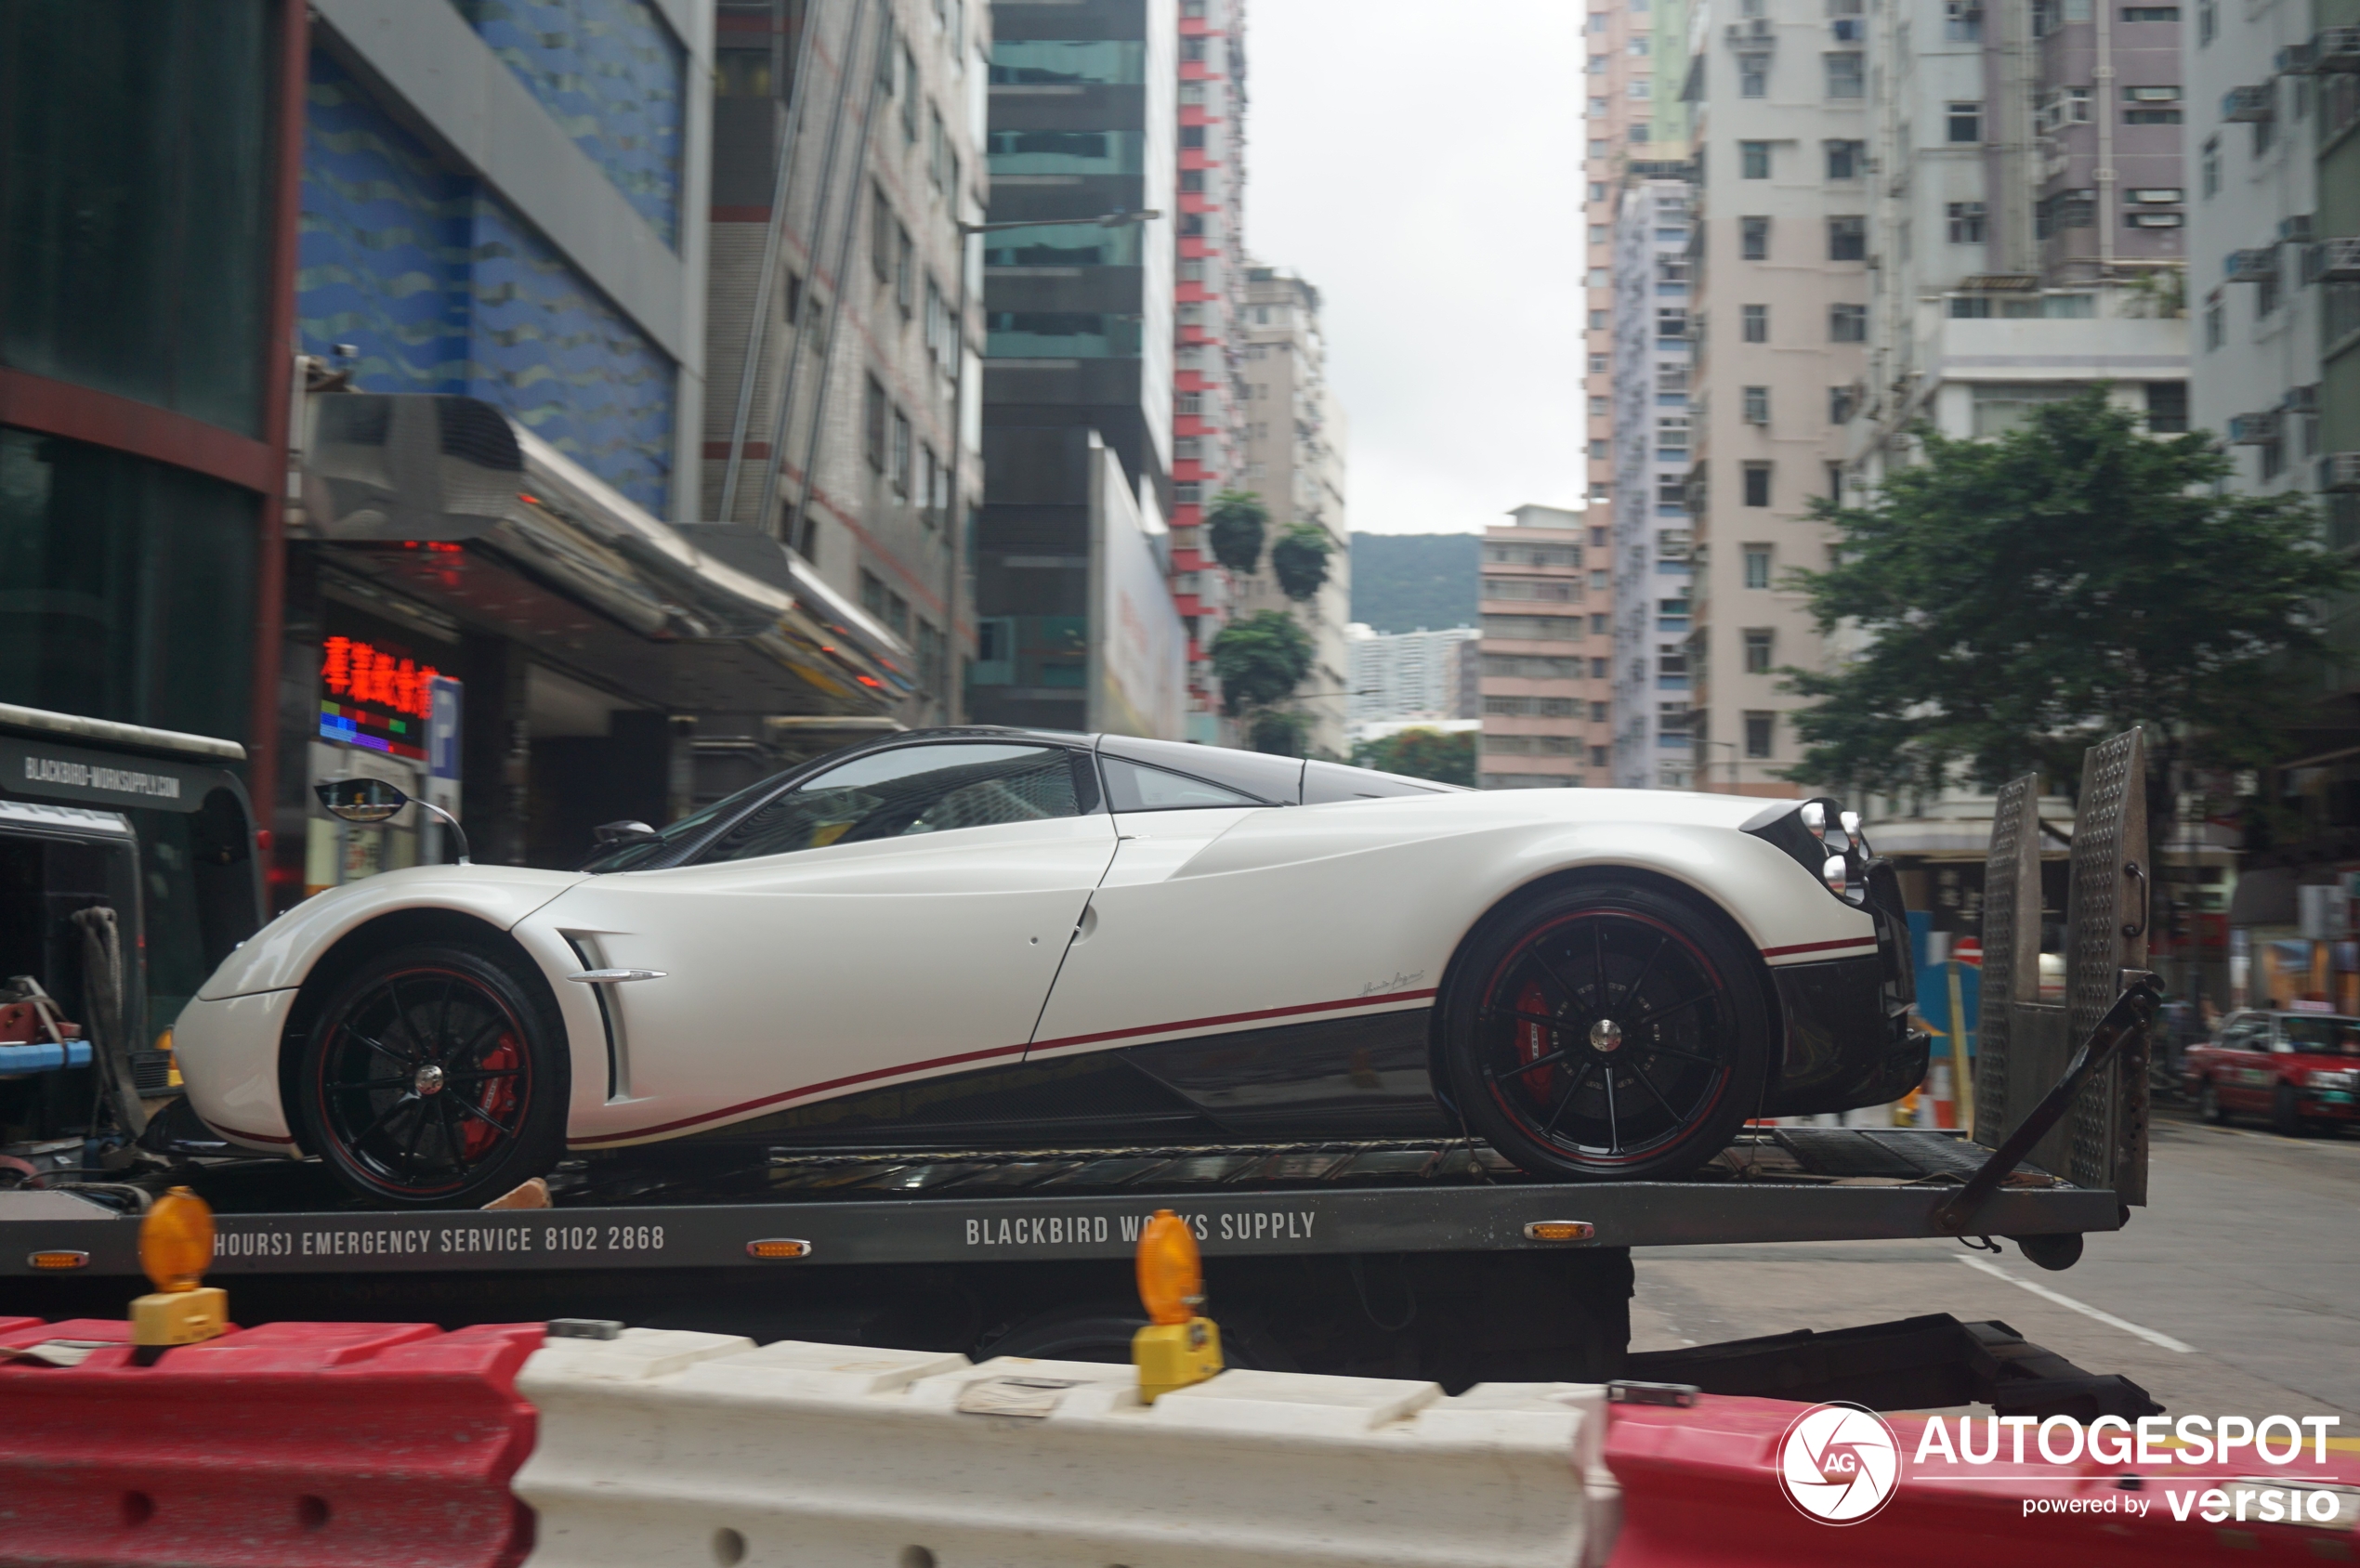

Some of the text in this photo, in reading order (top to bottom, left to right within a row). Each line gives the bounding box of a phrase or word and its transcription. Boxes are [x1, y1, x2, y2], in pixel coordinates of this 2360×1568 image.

[213, 1226, 664, 1255] HOURS) EMERGENCY SERVICE 8102 2868
[966, 1211, 1316, 1245] BLACKBIRD WOKS SUPPLY
